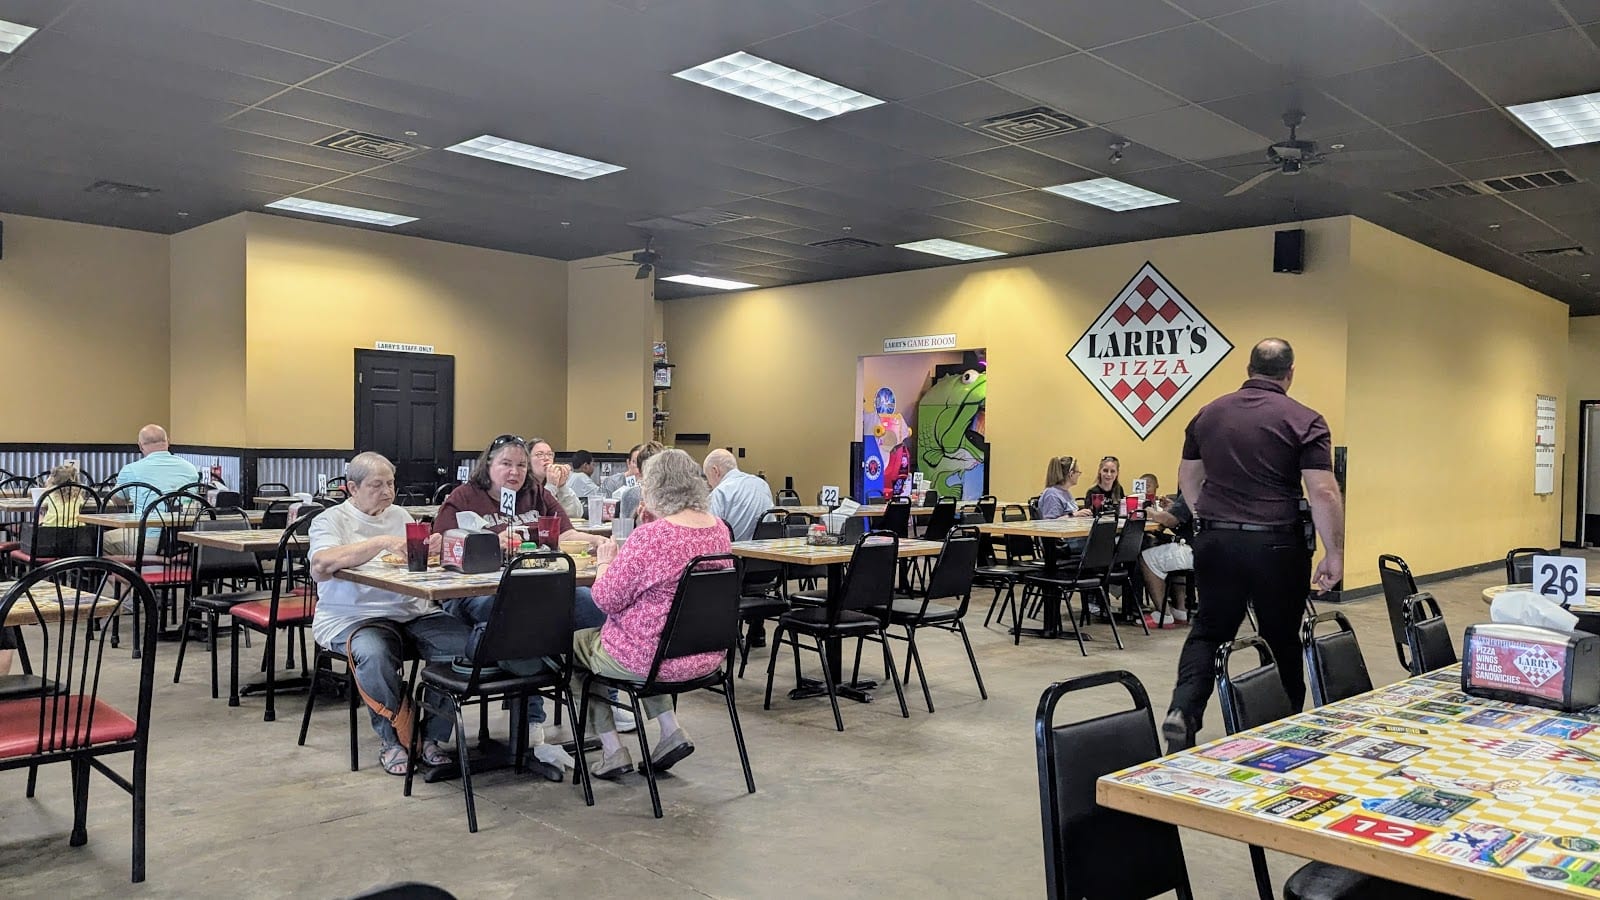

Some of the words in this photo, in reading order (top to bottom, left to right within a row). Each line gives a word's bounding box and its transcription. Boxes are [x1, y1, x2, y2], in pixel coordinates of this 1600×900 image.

[907, 338, 930, 348] GAME
[931, 336, 955, 346] ROOM
[1087, 324, 1208, 359] LARRY'S
[1102, 359, 1190, 377] PIZZA
[1135, 481, 1145, 491] 21
[502, 492, 514, 510] 23
[824, 489, 837, 502] 22
[1540, 563, 1579, 597] 26
[1476, 646, 1496, 655] PIZZA
[1476, 655, 1498, 664] WINGS
[1518, 657, 1558, 670] LARRY'S
[1475, 662, 1503, 673] SALADS
[1523, 666, 1551, 674] PIZZA
[1475, 670, 1521, 685] SANDWICHES
[1351, 819, 1414, 842] 12
